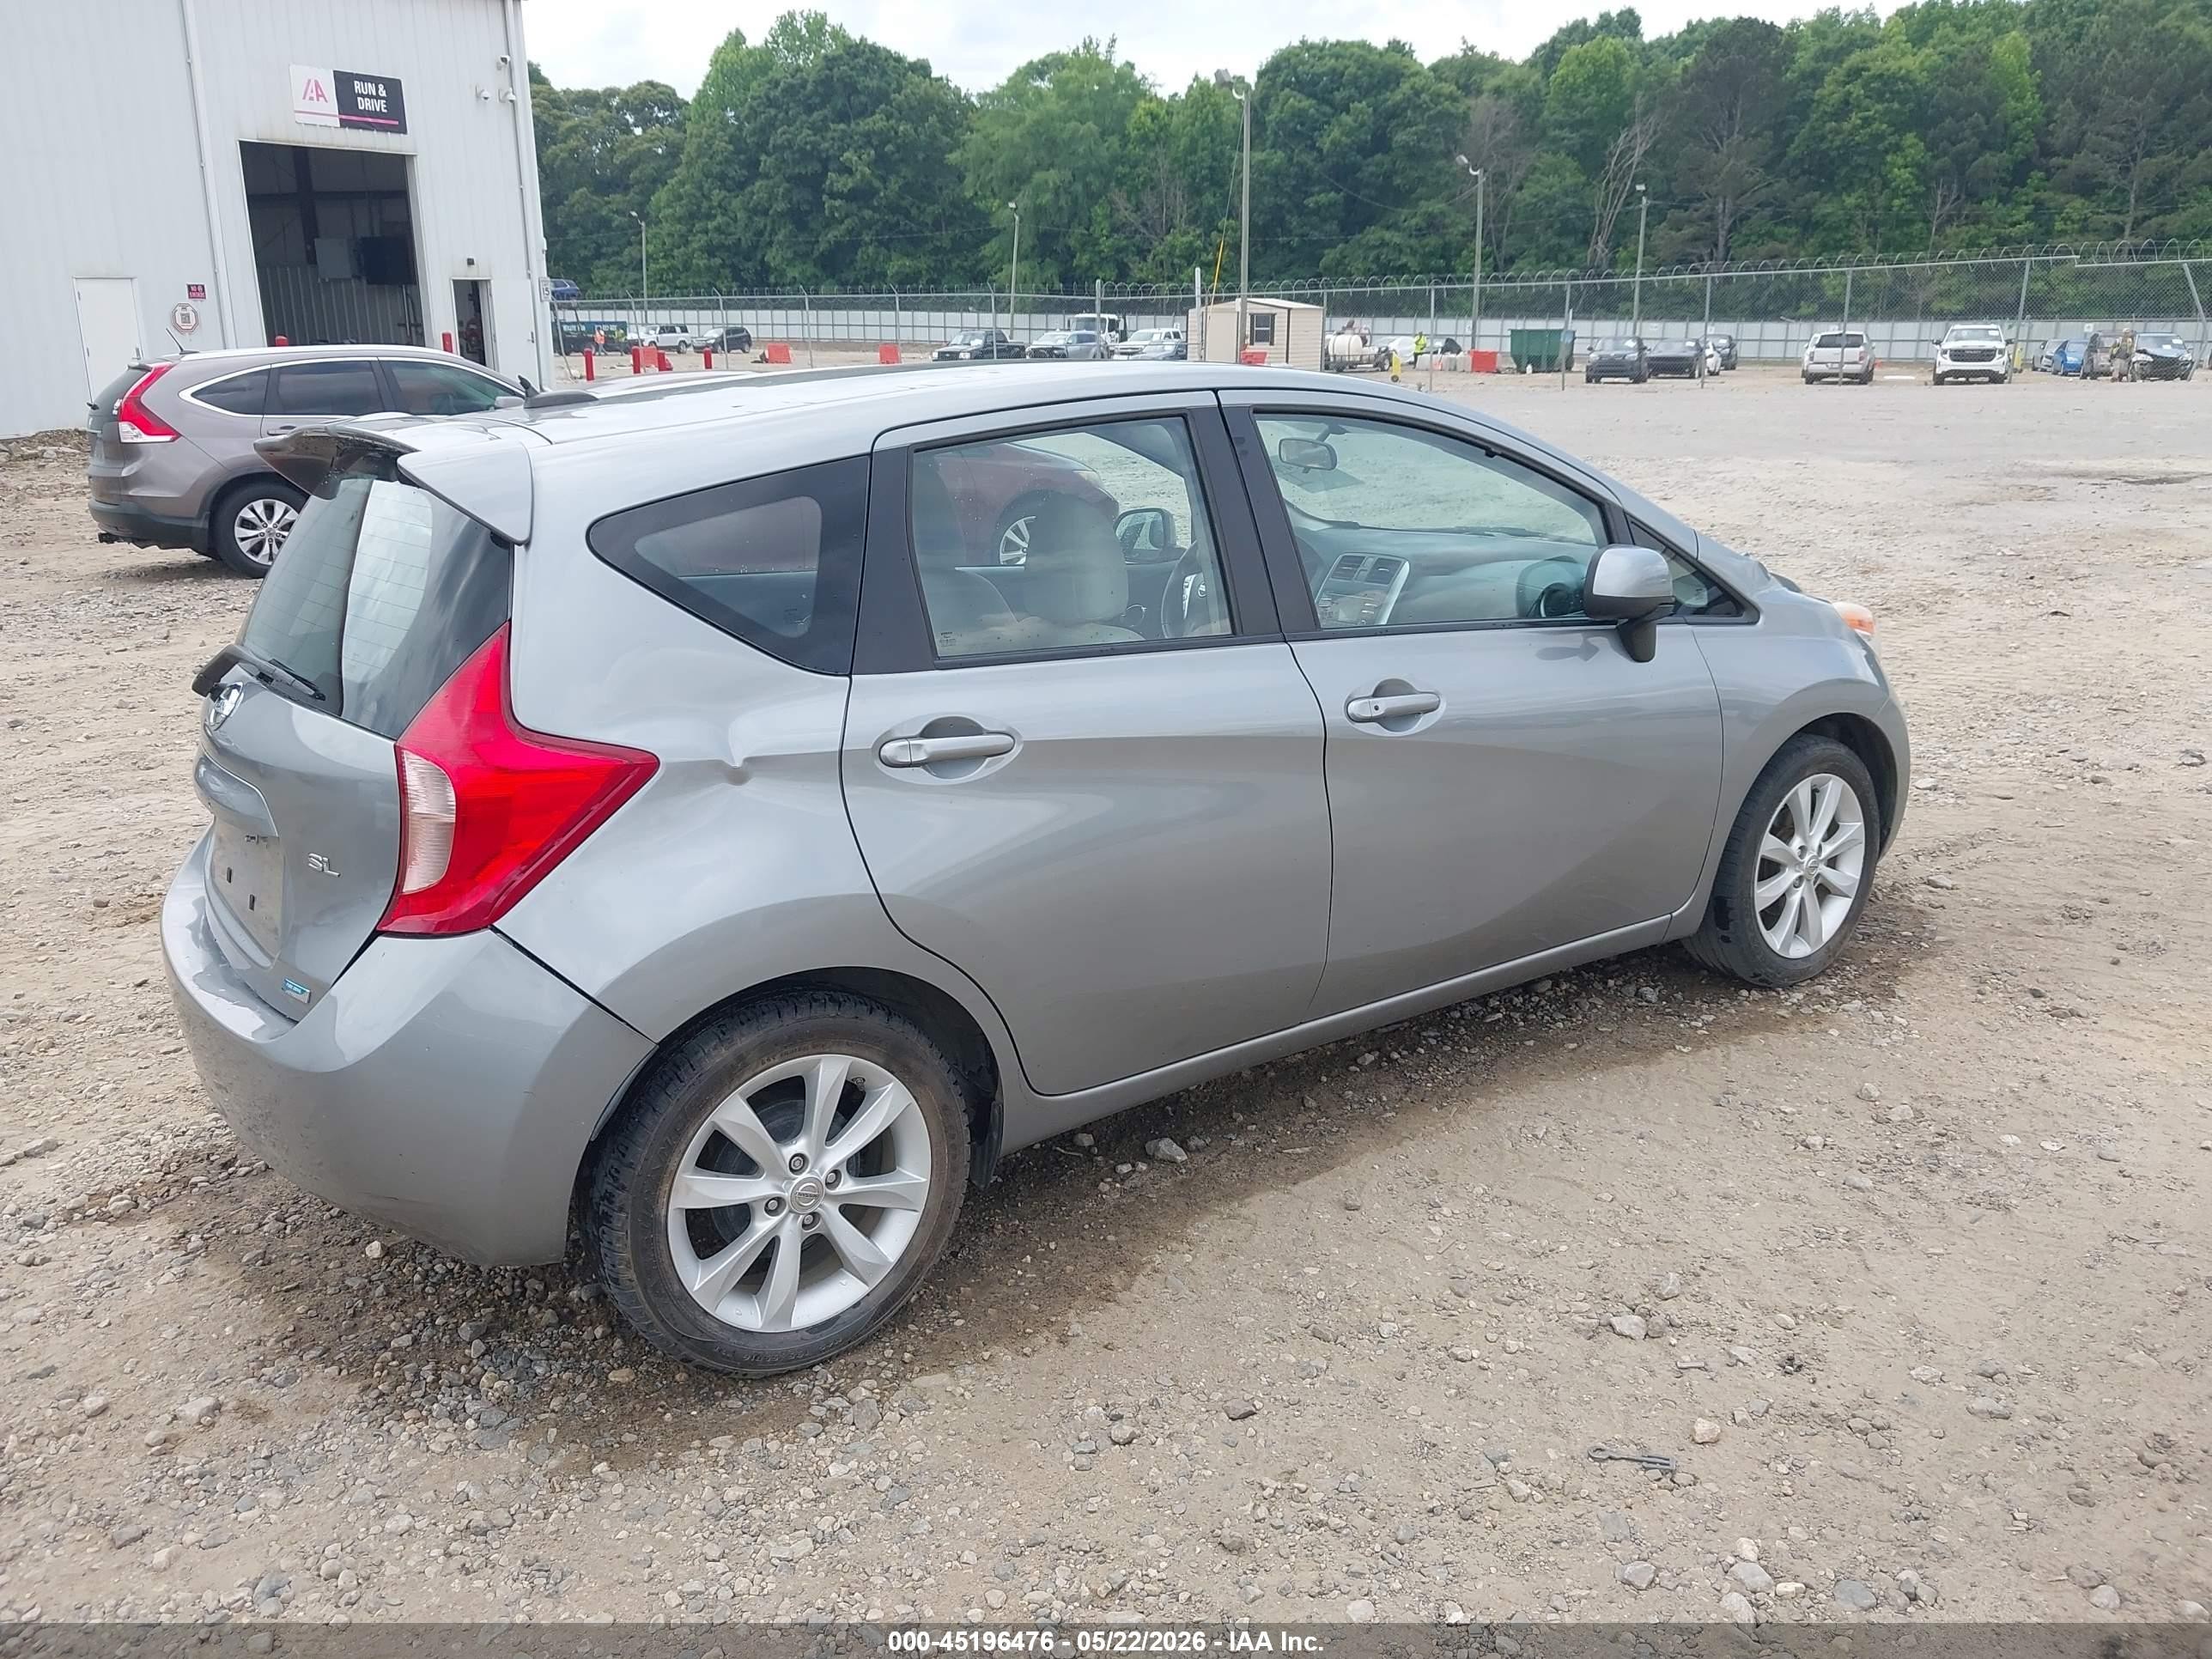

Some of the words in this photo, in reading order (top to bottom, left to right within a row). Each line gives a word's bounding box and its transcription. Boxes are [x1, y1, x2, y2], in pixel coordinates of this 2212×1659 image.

[354, 80, 376, 96] RUN
[378, 83, 387, 97] &
[357, 96, 388, 113] DRIVE
[542, 287, 550, 296] 15
[308, 853, 340, 877] SL
